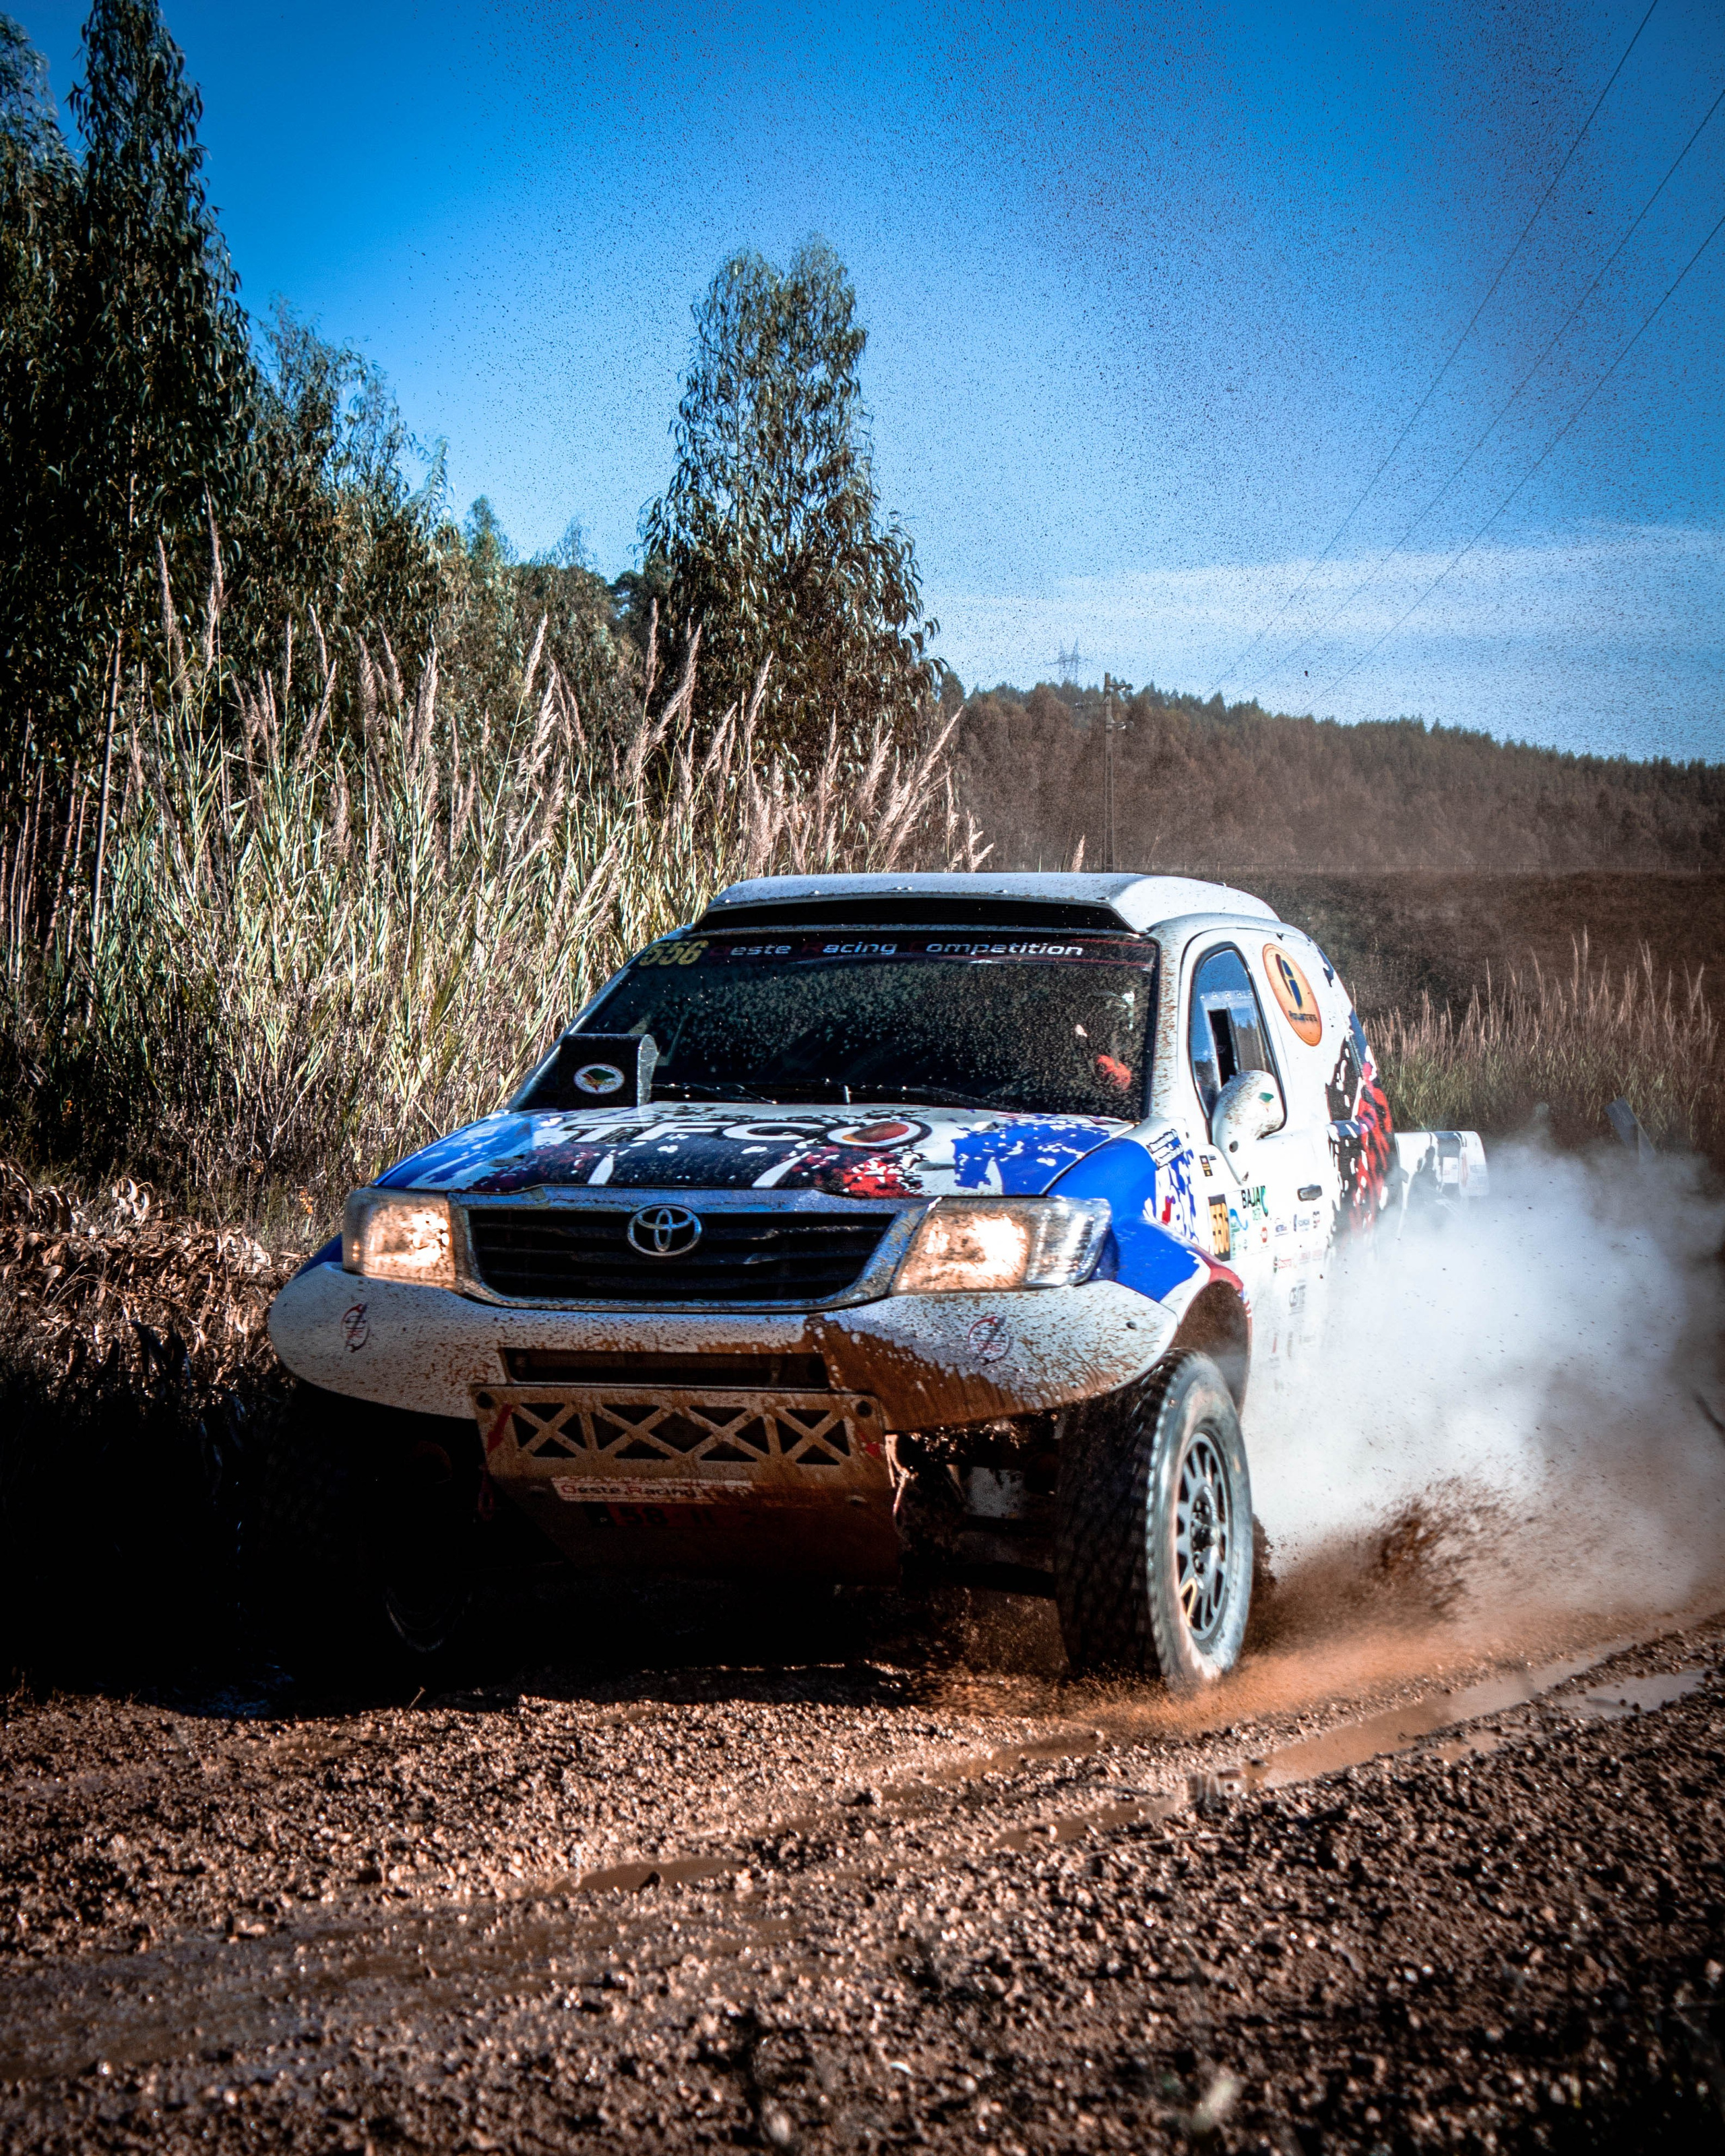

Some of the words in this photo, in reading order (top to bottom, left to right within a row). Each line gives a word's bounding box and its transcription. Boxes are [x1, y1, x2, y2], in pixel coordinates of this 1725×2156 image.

[639, 940, 710, 966] 556
[1241, 1186, 1261, 1209] BAJA
[561, 1485, 621, 1494] Oeste
